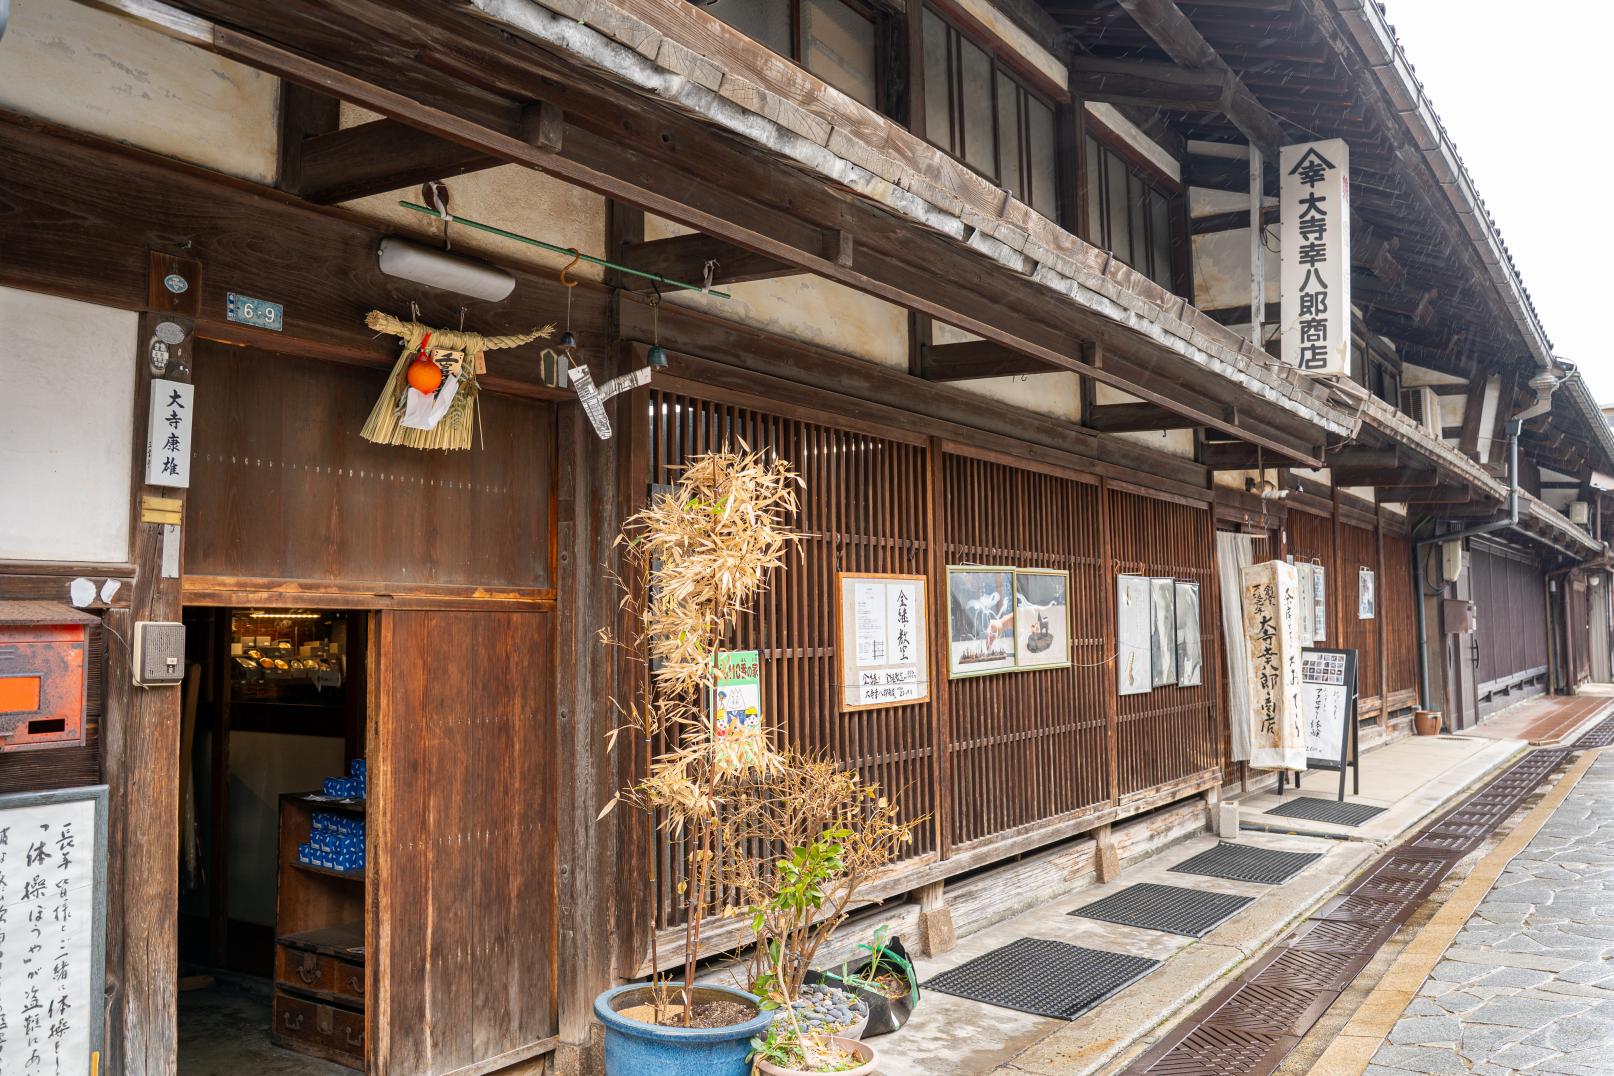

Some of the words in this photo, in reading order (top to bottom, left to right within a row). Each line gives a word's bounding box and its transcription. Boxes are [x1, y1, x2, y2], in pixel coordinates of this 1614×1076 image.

[244, 303, 275, 323] 6-9
[1298, 191, 1329, 371] 大寺幸八郎商店
[161, 389, 185, 476] 大寺康雄
[1257, 615, 1279, 735] 大寺幸八郎商店
